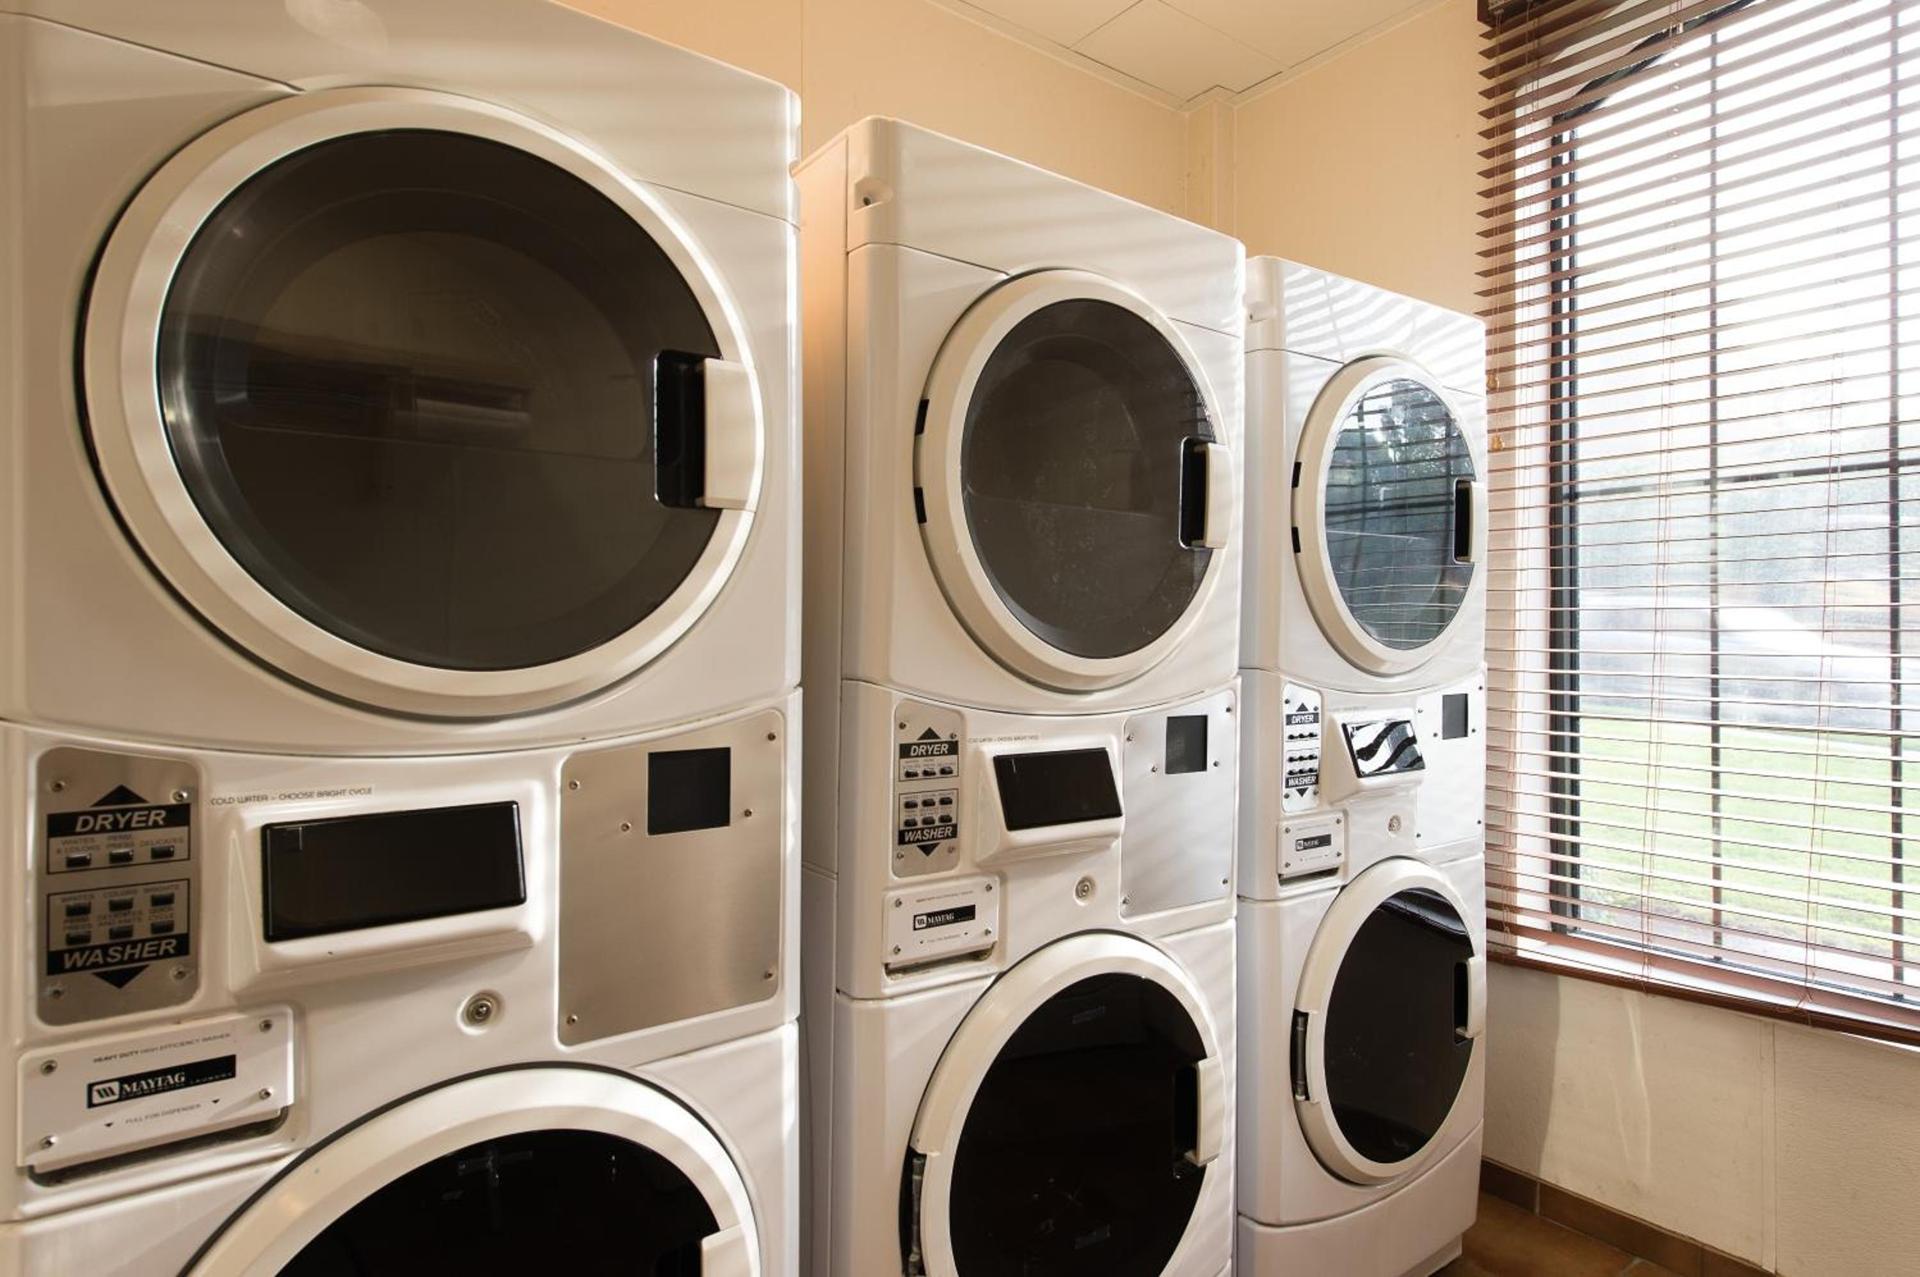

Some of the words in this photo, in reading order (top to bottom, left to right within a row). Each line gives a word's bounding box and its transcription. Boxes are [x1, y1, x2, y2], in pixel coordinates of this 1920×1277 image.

[1291, 714, 1314, 724] DRYER
[910, 743, 949, 756] DRYER
[211, 797, 234, 806] COLD
[278, 791, 313, 801] CHOOSE
[317, 788, 346, 797] BRIGHT
[75, 810, 166, 833] DRYER
[904, 826, 952, 842] WASHER
[63, 939, 177, 969] WASHER
[119, 1049, 139, 1059] DUTY
[122, 1071, 186, 1094] MAYTAG
